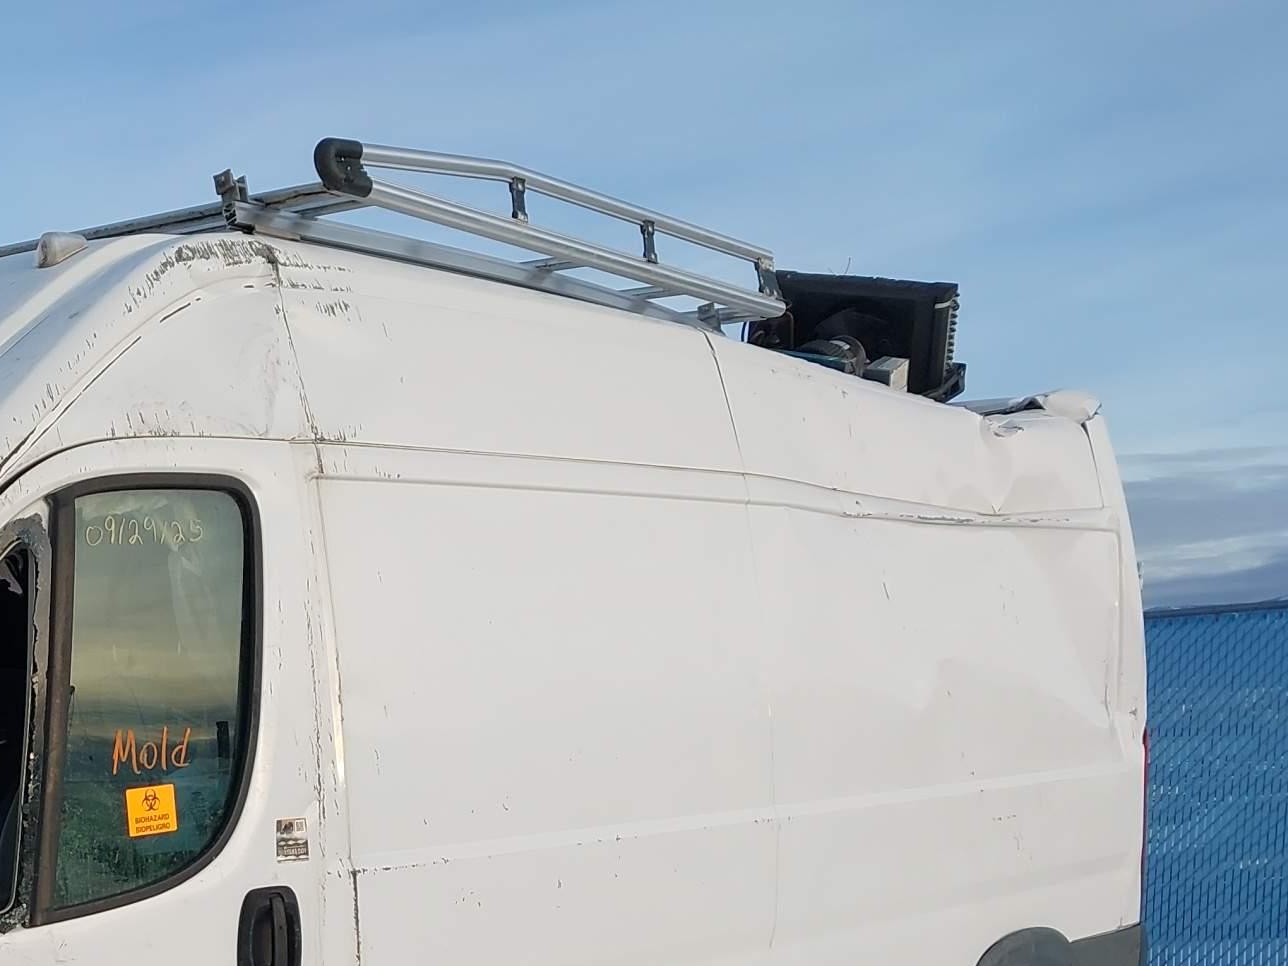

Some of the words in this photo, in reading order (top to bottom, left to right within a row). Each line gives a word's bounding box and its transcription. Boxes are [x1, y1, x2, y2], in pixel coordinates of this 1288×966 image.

[113, 726, 191, 775] Mold
[134, 813, 170, 825] BIOHAZARD
[135, 823, 171, 834] BIOPELIGRO
